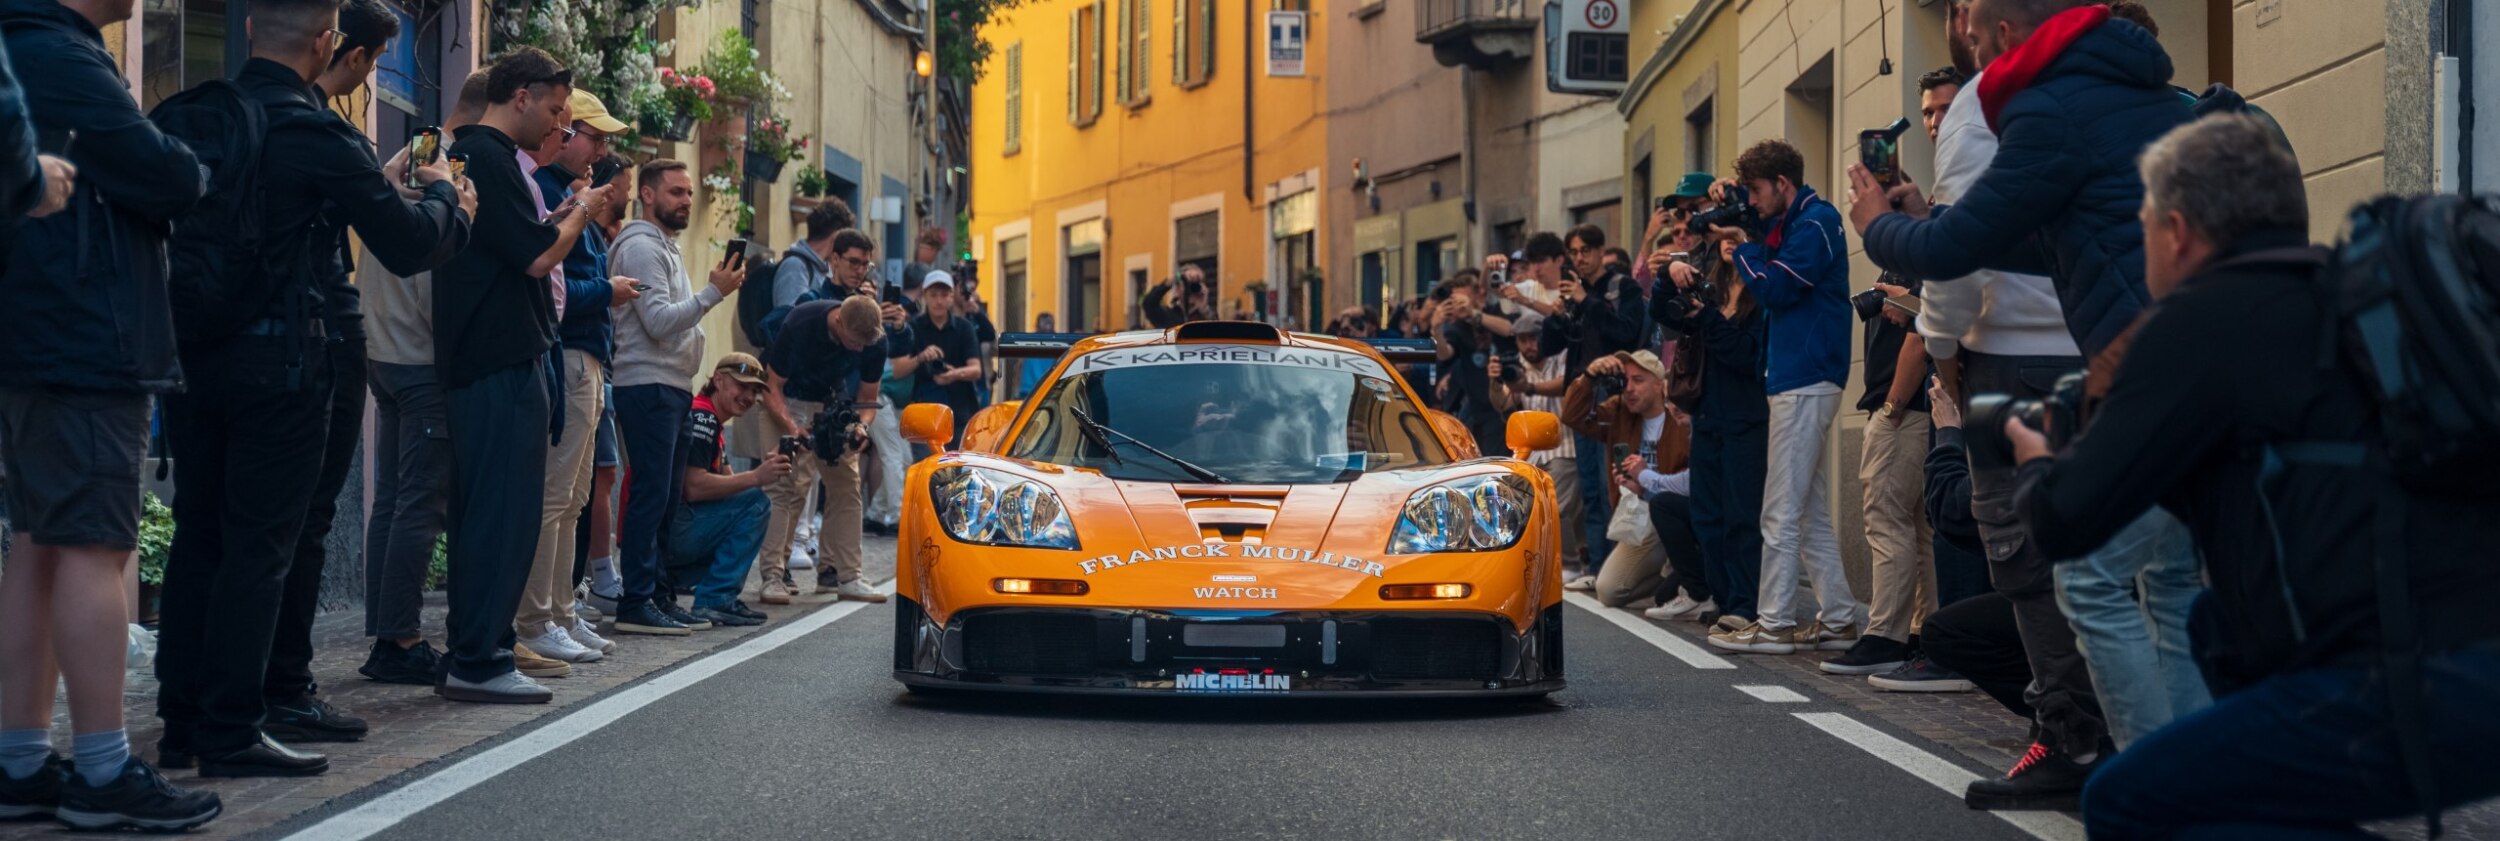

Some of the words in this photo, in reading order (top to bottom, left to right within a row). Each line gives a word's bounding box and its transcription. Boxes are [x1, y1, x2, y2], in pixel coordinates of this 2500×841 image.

[1592, 5, 1611, 21] 30
[1132, 351, 1328, 367] KAPRIELIAN
[1078, 544, 1229, 575] FRANCK
[1241, 545, 1385, 578] MULLER
[1193, 587, 1278, 599] WATCH
[1176, 673, 1290, 690] MICHELIN
